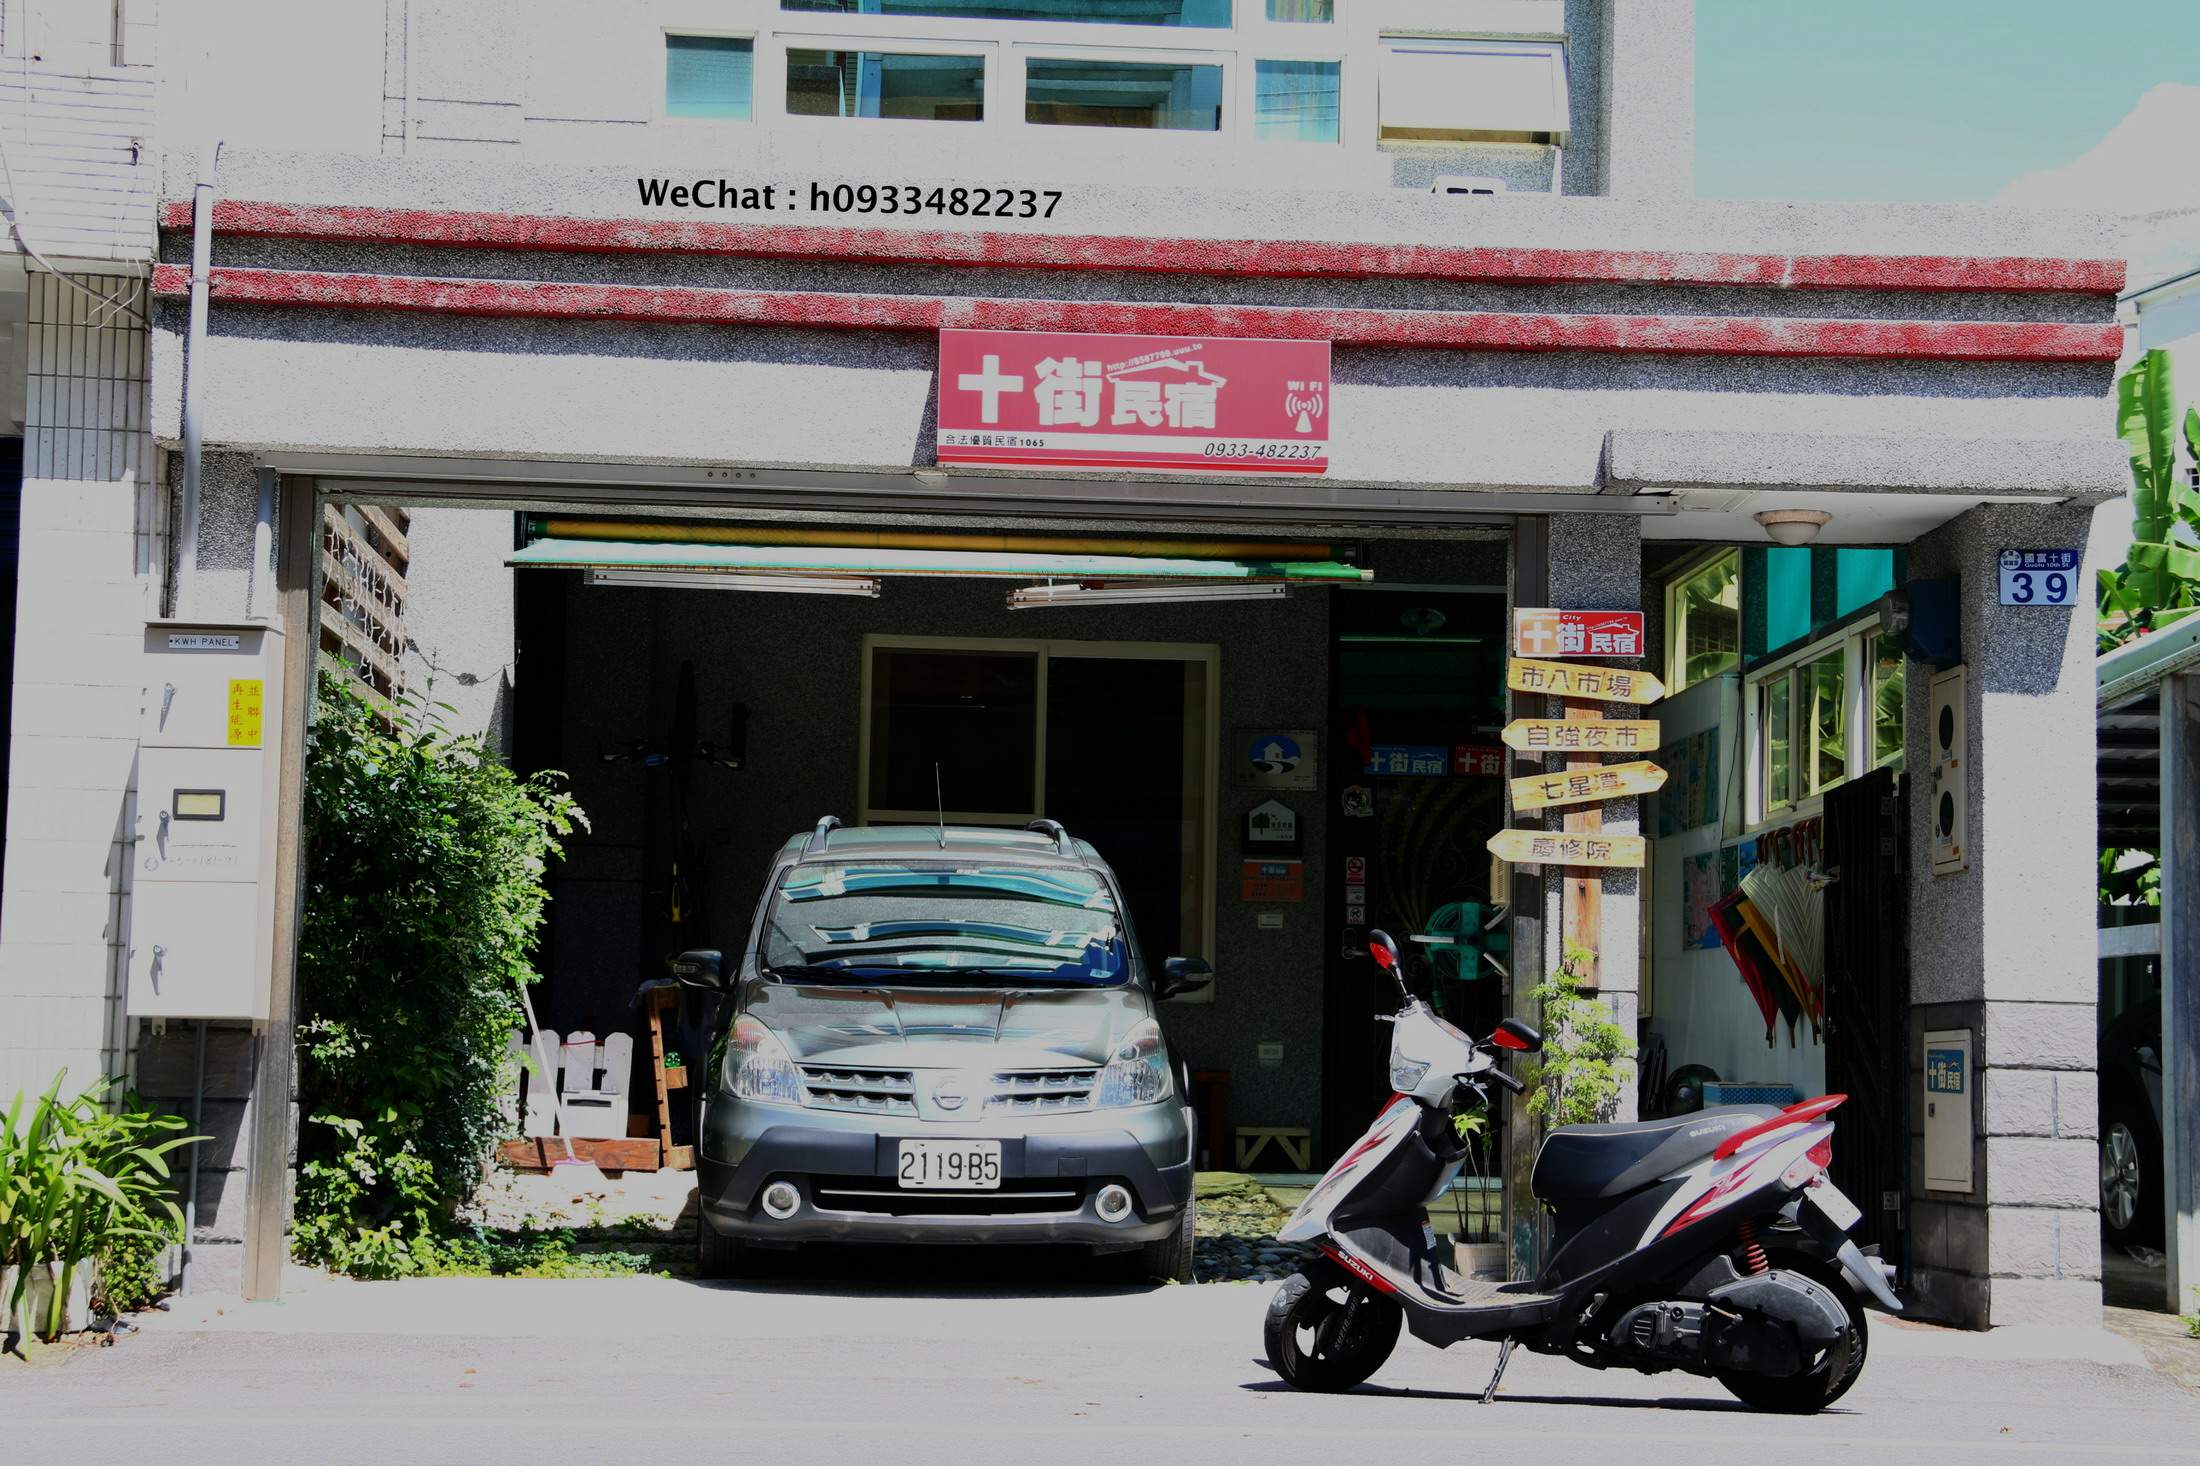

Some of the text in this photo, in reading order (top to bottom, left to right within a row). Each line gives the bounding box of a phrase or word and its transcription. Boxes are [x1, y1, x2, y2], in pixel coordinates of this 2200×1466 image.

[957, 354, 1218, 430] 十街民宿
[1204, 442, 1322, 459] 0933-482237
[2011, 572, 2068, 604] 39
[174, 637, 234, 648] KWH PANEL
[1522, 621, 1637, 654] 十街民宿
[1527, 724, 1639, 747] 自強夜市
[1337, 1250, 1374, 1281] SUZUKI
